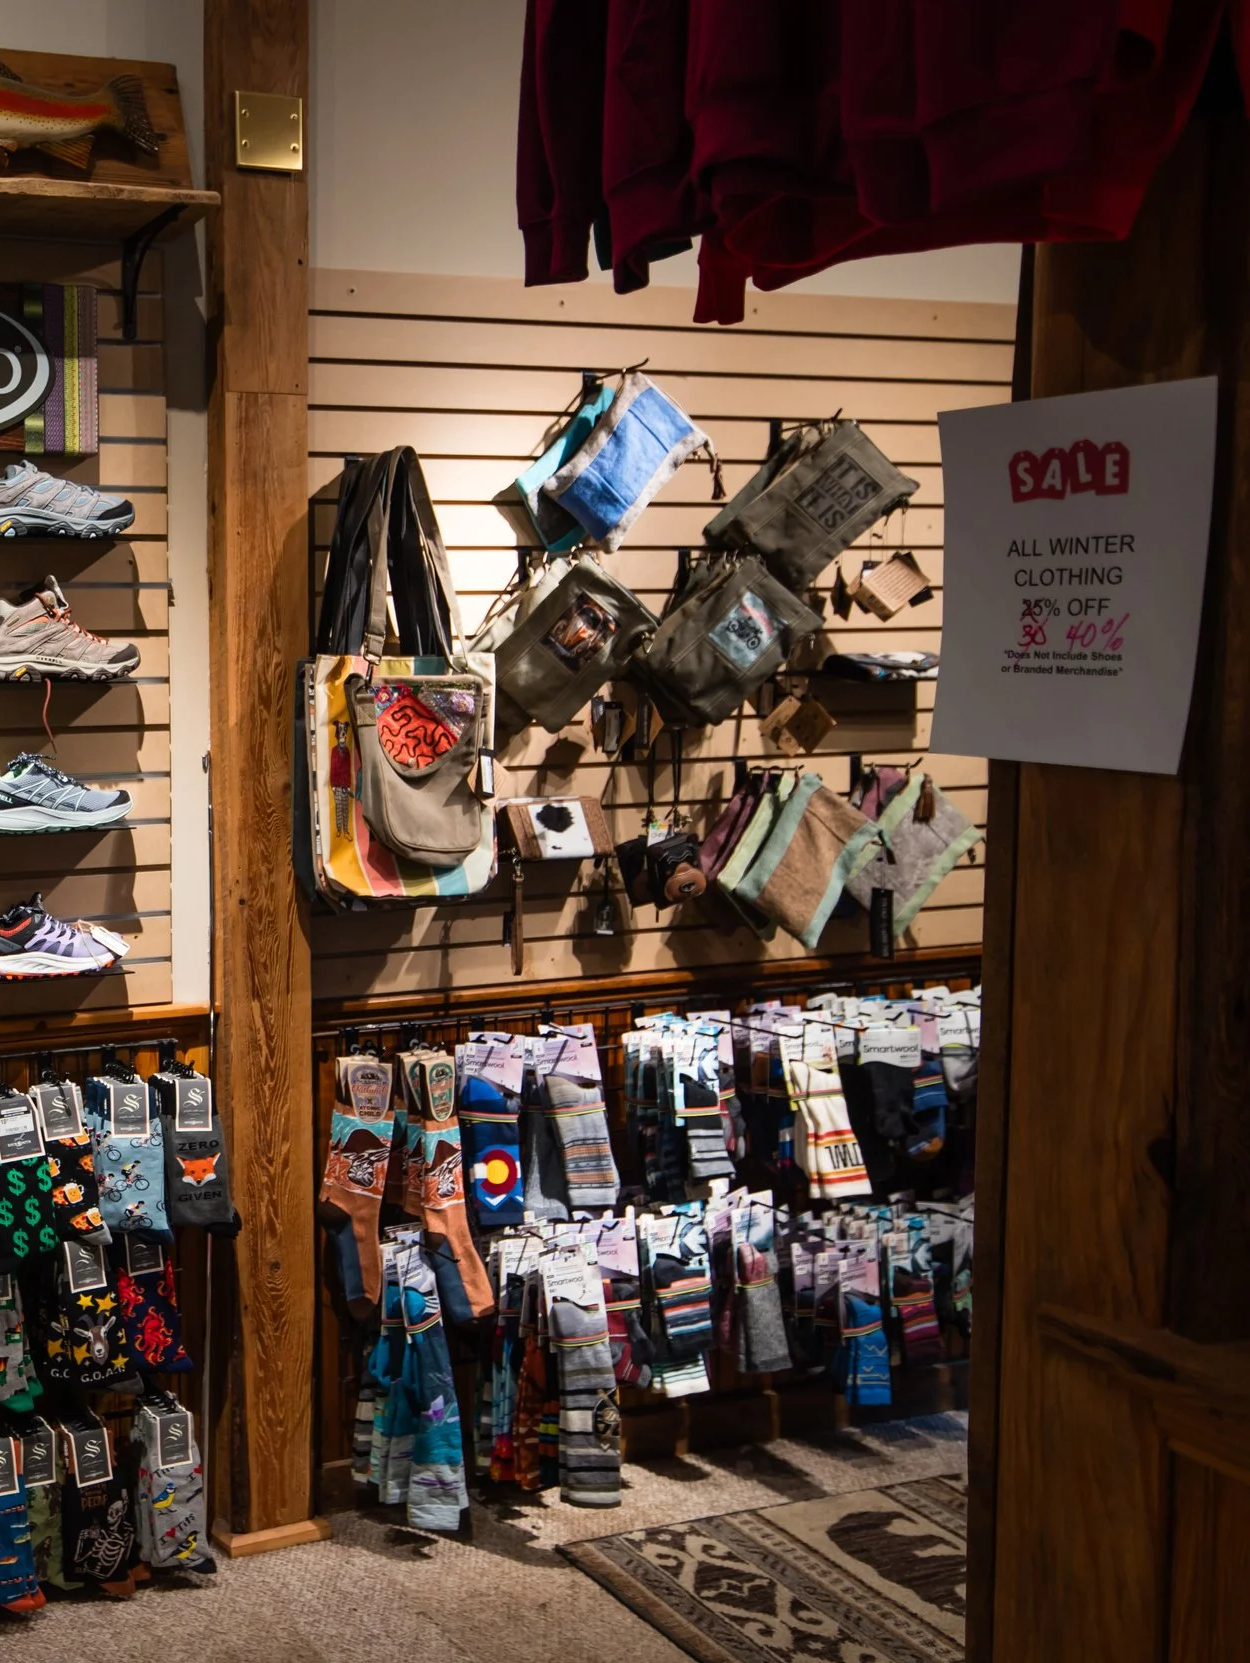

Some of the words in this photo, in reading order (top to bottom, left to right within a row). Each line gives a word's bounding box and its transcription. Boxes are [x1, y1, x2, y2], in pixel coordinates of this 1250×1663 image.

[1014, 451, 1124, 495] SALE
[1007, 539, 1043, 558] ALL
[1049, 534, 1136, 555] WINTER
[1014, 566, 1123, 587] CLOTHING
[1067, 597, 1111, 617] OFF
[1033, 650, 1050, 660] Not
[1052, 650, 1088, 661] Include
[1091, 651, 1123, 662] Shoes
[1001, 665, 1011, 673] or
[1013, 664, 1053, 674] Branded
[862, 1043, 919, 1054] Smartwool
[177, 1139, 220, 1152] ZERO
[177, 1190, 223, 1203] GIVEN
[546, 1276, 584, 1288] Smartwool
